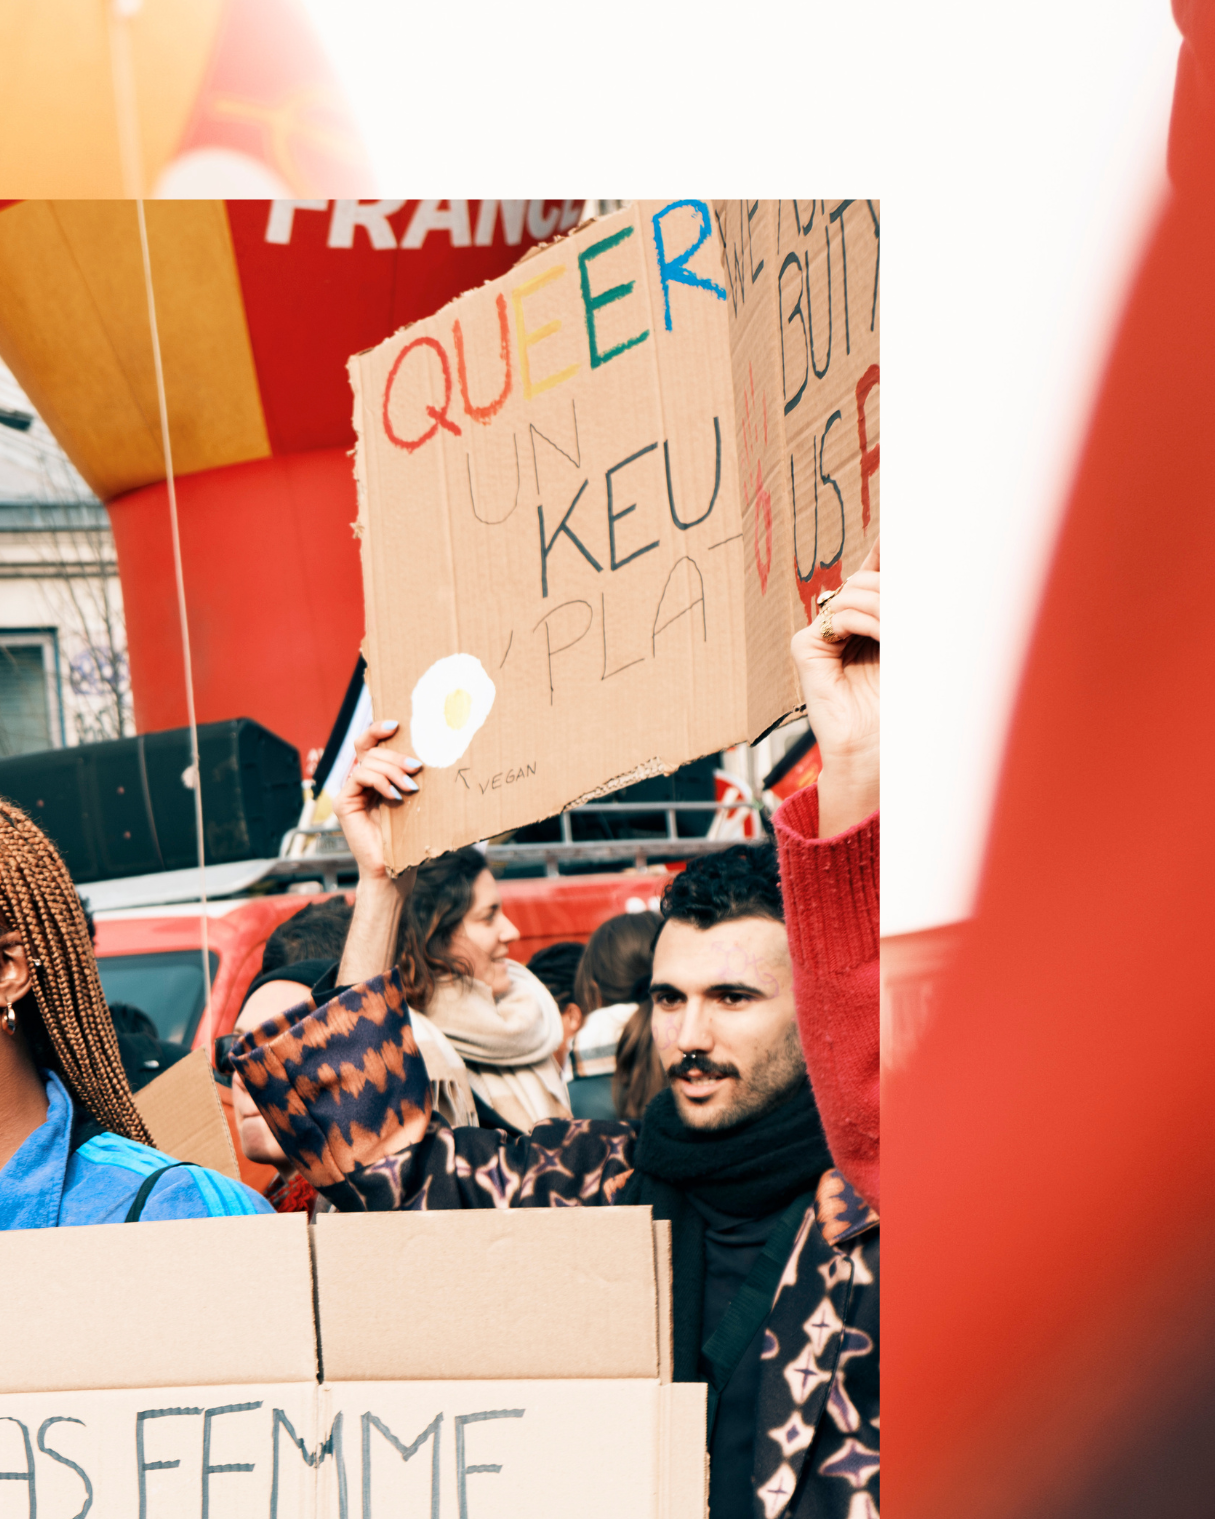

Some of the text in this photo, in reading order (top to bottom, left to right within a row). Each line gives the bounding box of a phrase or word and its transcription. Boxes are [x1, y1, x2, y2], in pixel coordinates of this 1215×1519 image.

[383, 198, 727, 453] QUEER
[467, 398, 581, 525] UN
[537, 416, 722, 598] KEU
[478, 761, 538, 795] VEGAN
